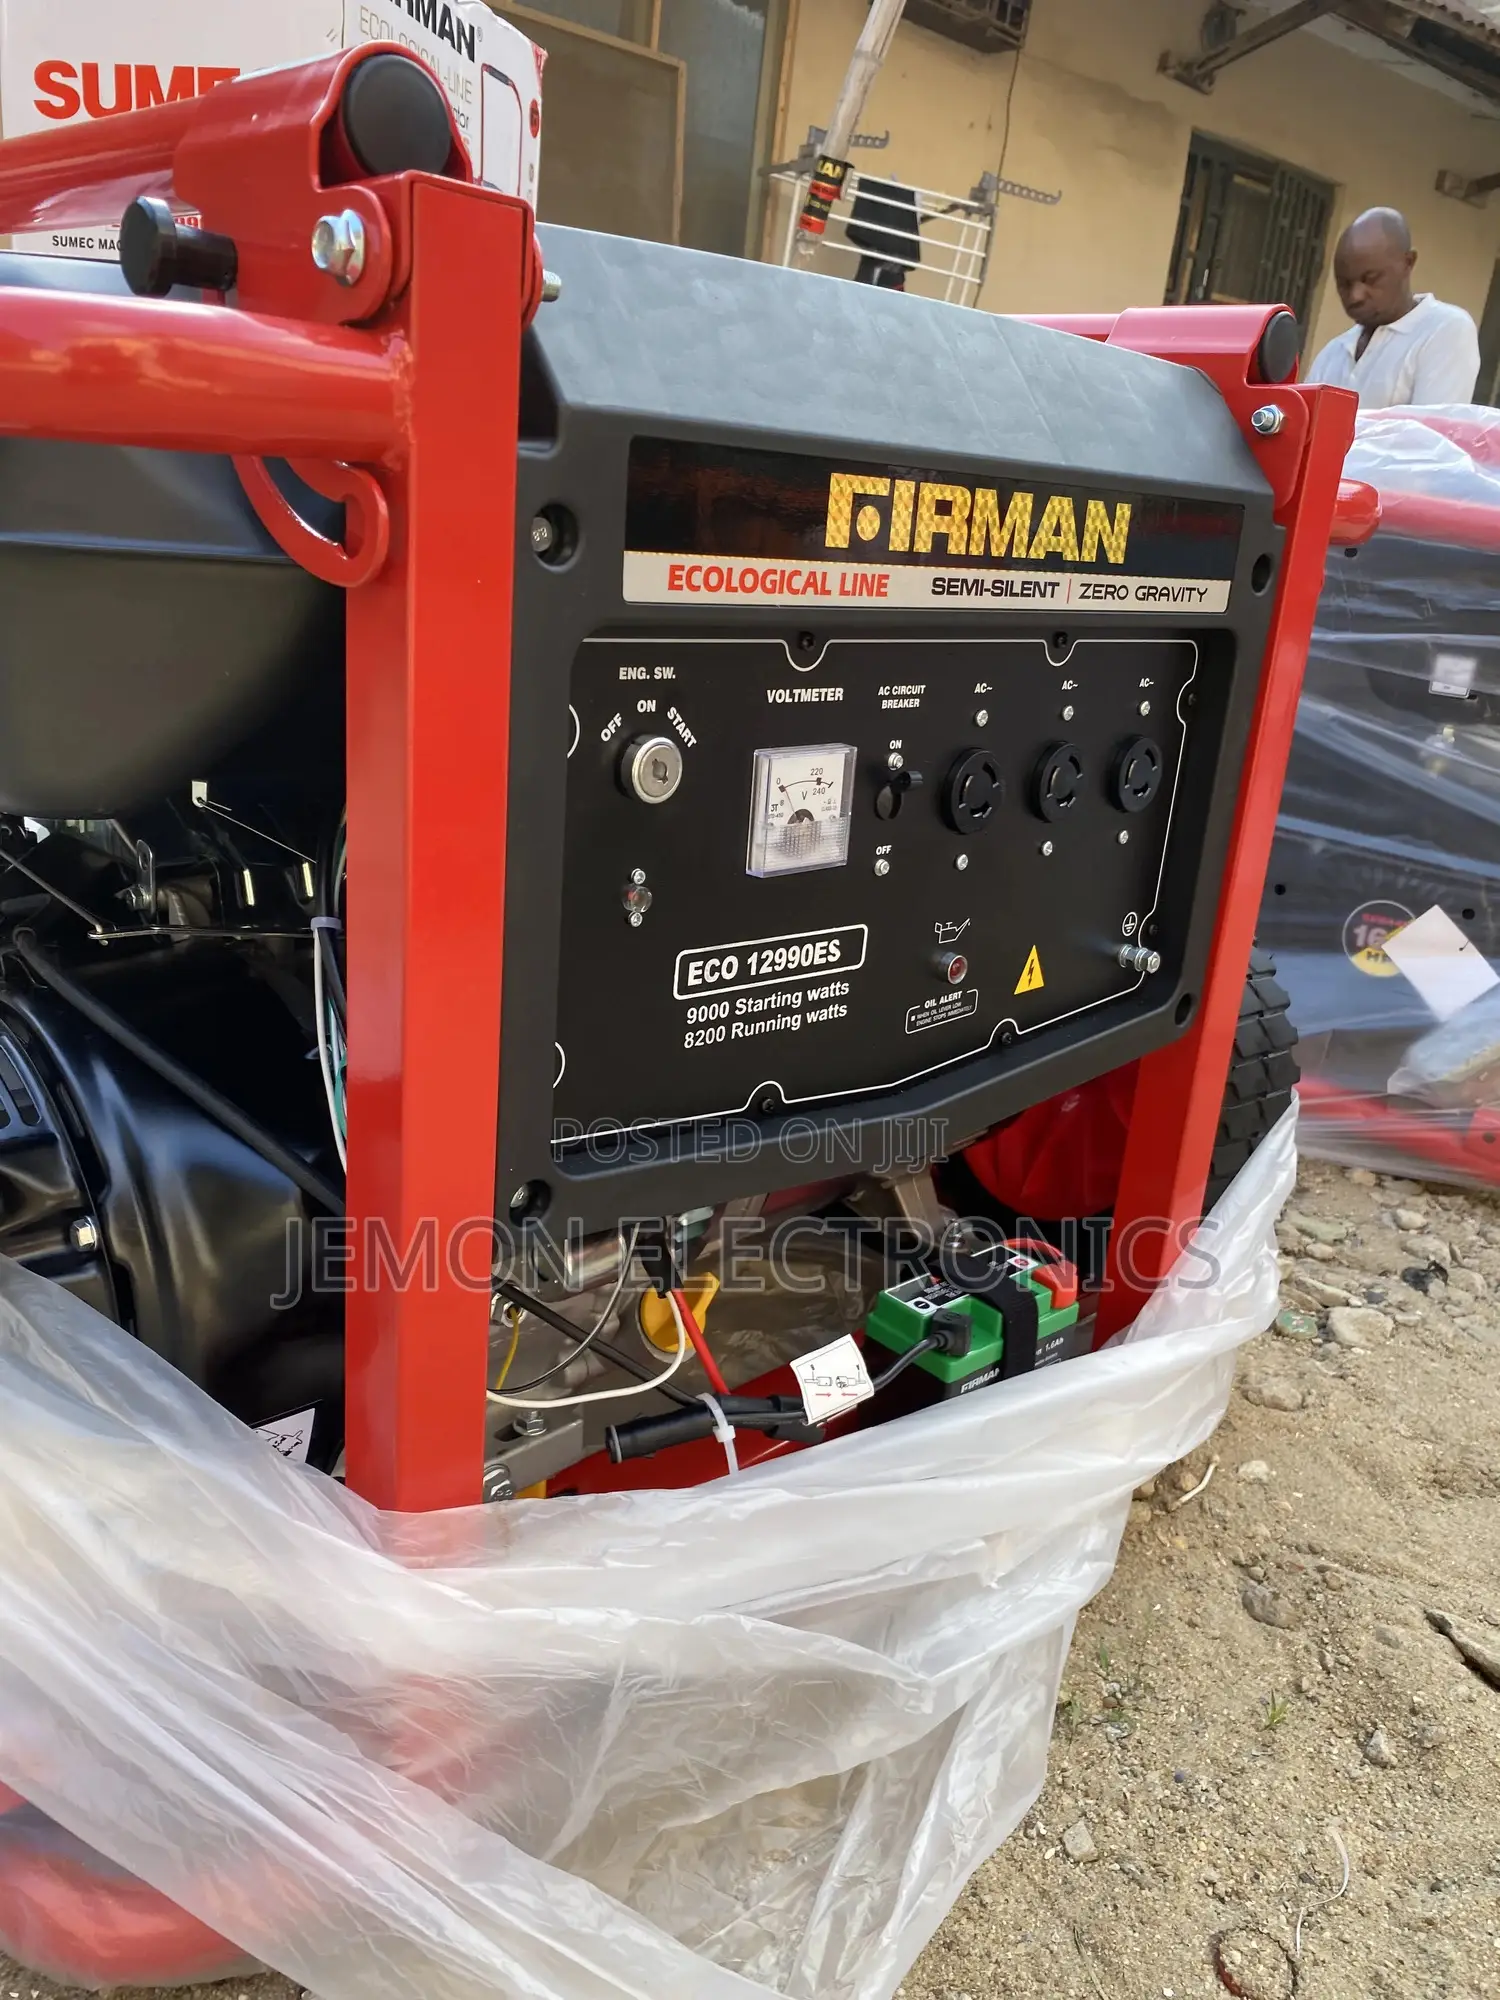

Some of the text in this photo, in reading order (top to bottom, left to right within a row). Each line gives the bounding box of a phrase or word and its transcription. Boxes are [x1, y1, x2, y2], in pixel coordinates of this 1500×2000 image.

[52, 235, 94, 249] SUMEC
[824, 472, 1132, 564] FIRMAN
[667, 564, 1208, 603] ECOLOGICAL LINE SEMI-SILENT ZERO GRAVITY
[619, 666, 676, 680] ENG. SW.
[766, 687, 844, 704] VOLTMETER
[878, 684, 926, 696] AC CIRCUIT
[637, 699, 656, 713] ON
[881, 698, 920, 709] BREAKER
[600, 712, 624, 743] OFF
[666, 706, 697, 748] START
[889, 739, 902, 749] ON
[810, 767, 823, 776] 220
[776, 777, 781, 785] 0
[801, 791, 807, 800] V
[812, 787, 826, 796] 240
[875, 845, 892, 856] OFF
[687, 939, 841, 986] ECO 12990ES
[686, 980, 850, 1025] 9000 Starting watts
[924, 990, 963, 1009] OIL ALERT
[683, 1003, 848, 1049] 8200 Running watts
